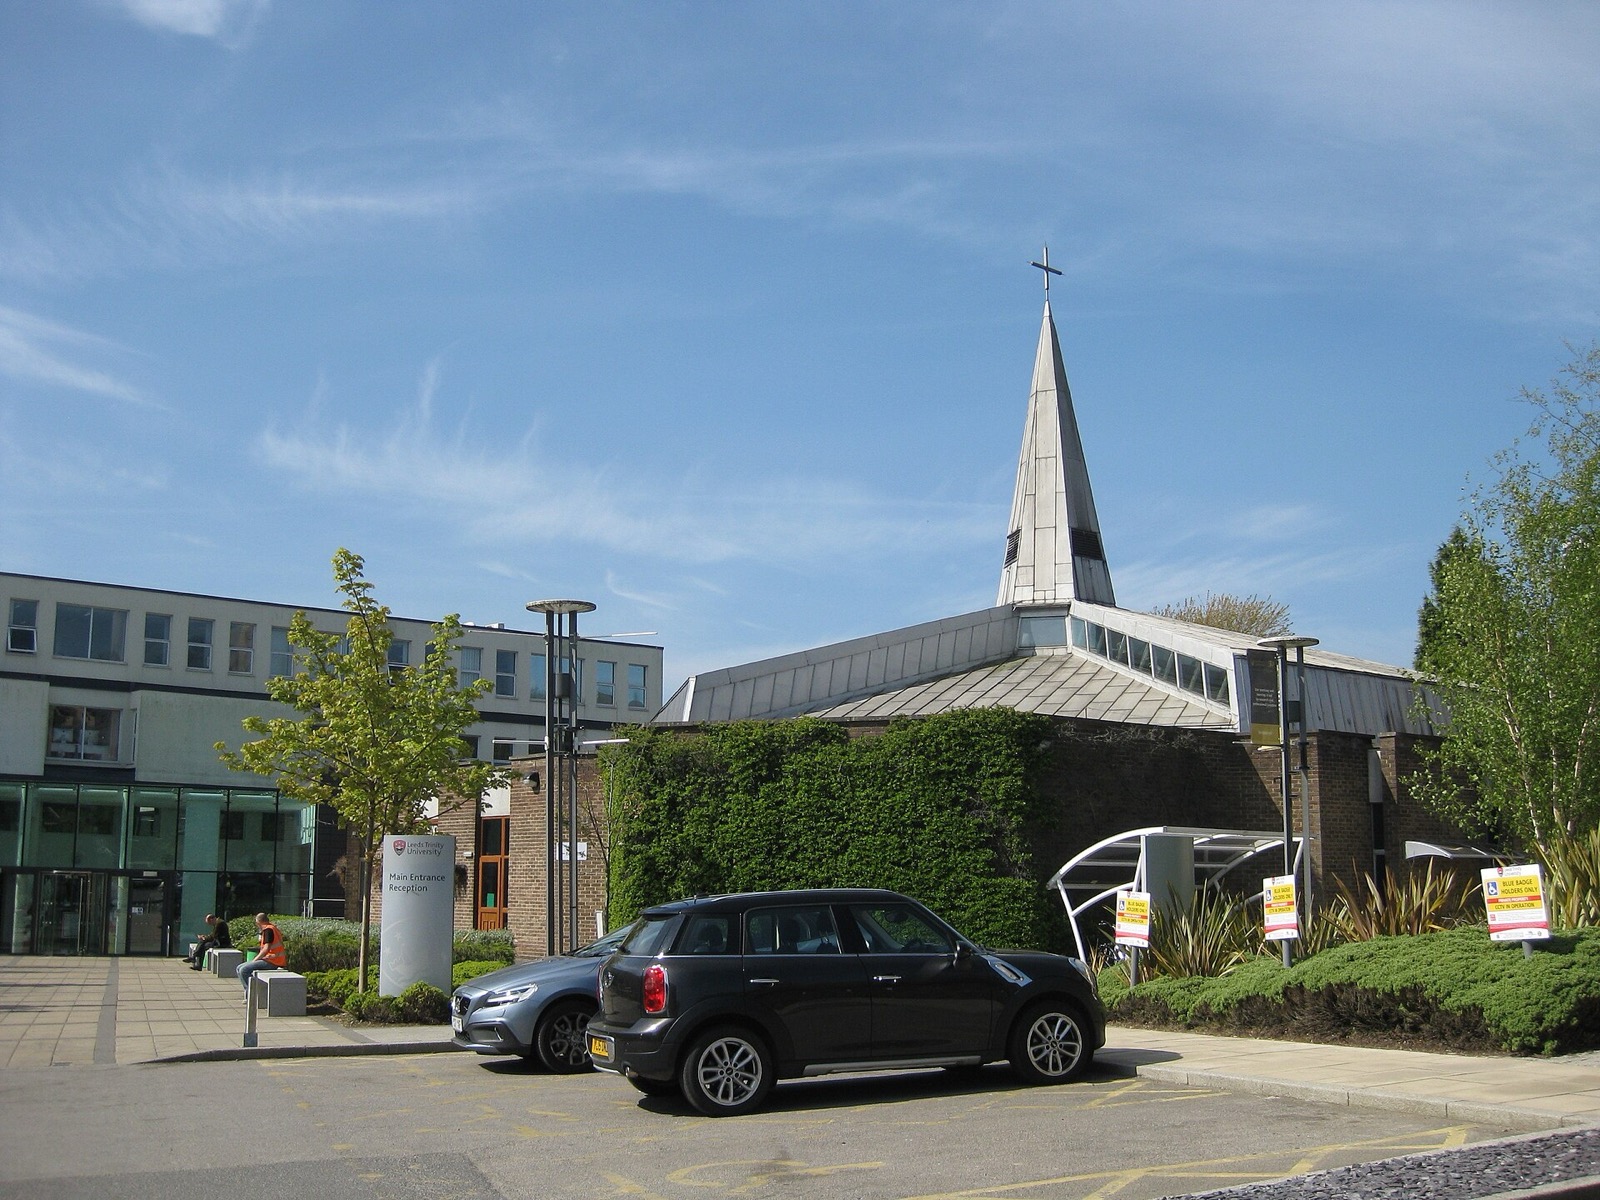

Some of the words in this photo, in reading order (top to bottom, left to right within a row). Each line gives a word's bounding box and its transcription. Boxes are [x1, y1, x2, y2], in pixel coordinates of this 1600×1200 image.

[425, 841, 445, 849] Trinity
[407, 848, 442, 857] University
[389, 873, 408, 881] Main
[409, 873, 446, 882] Entrance
[1515, 878, 1533, 886] BADGE
[388, 883, 428, 894] Reception
